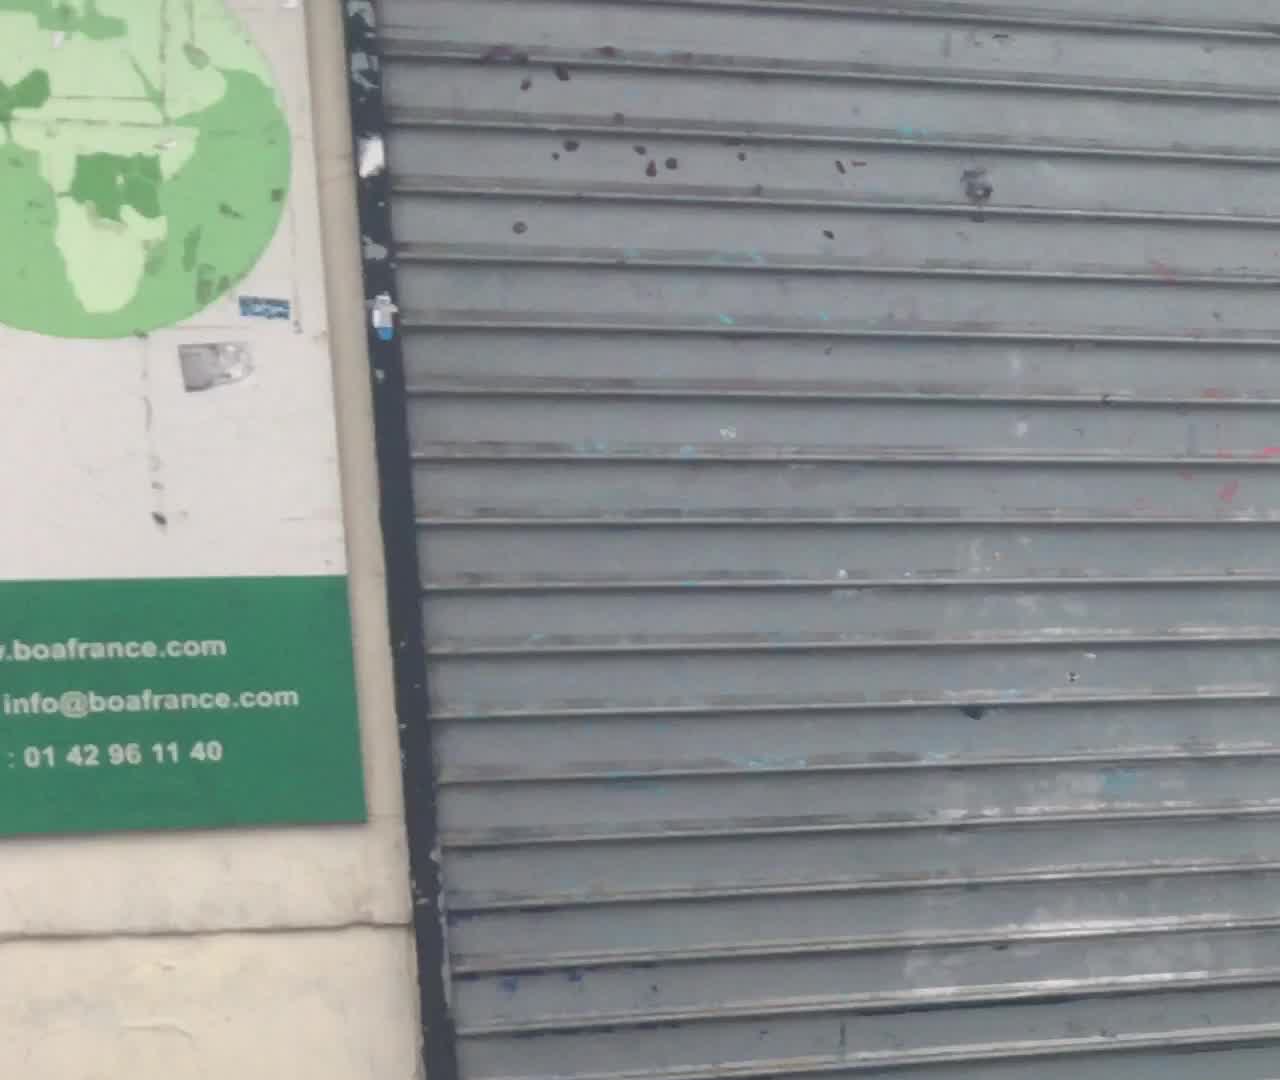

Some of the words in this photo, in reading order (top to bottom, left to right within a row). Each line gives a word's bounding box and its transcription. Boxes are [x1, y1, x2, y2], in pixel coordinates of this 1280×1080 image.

[0, 637, 227, 661] .boafrance.com
[3, 688, 300, 718] info@boafrance.com
[24, 745, 55, 768] 01
[66, 744, 99, 767] 42
[108, 742, 142, 765] 96
[152, 741, 179, 764] 11
[190, 740, 223, 761] 40
